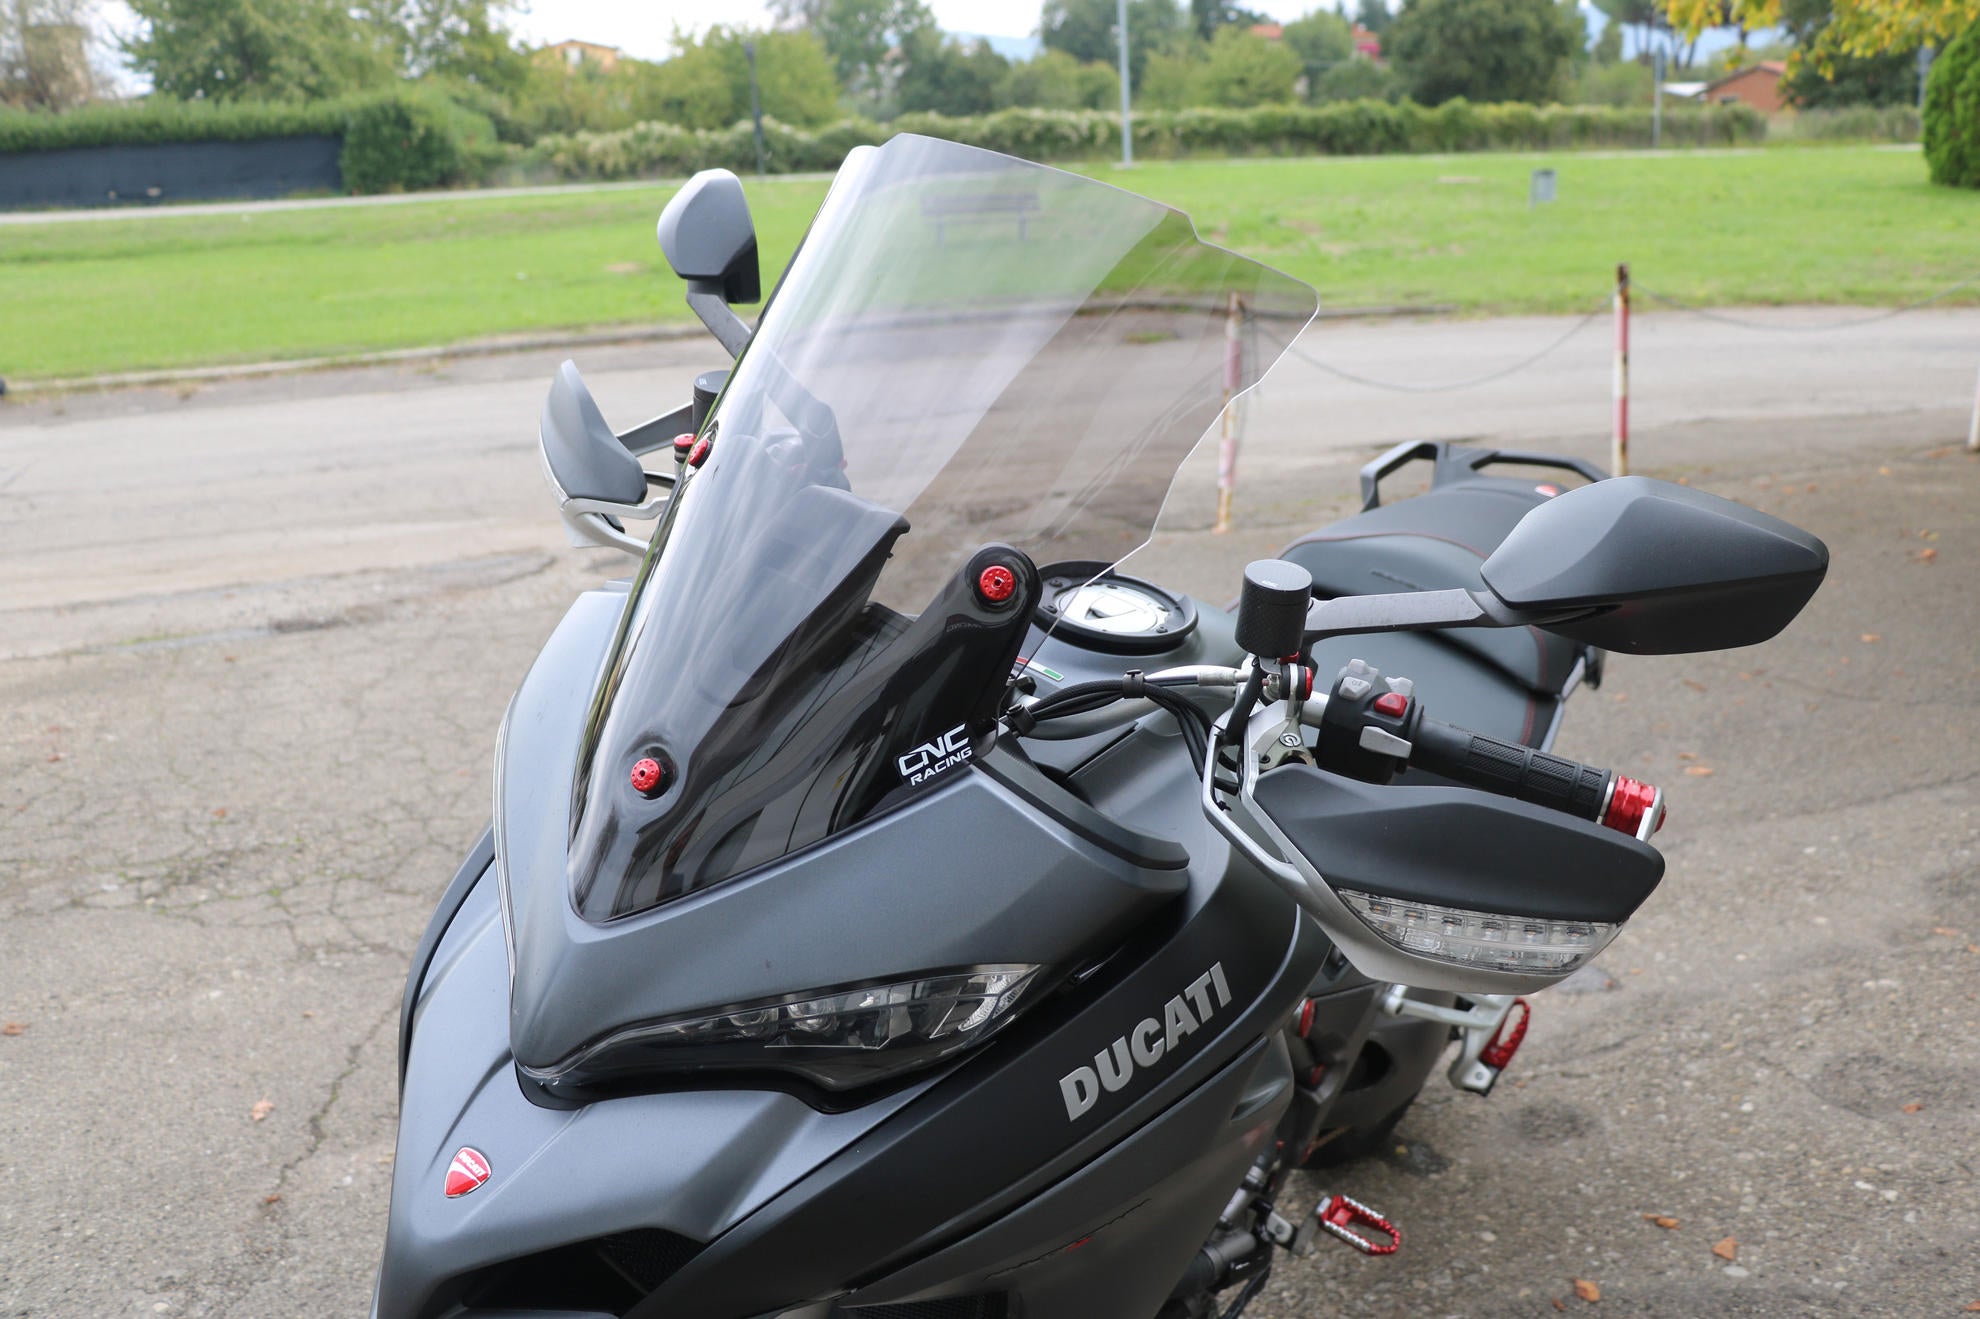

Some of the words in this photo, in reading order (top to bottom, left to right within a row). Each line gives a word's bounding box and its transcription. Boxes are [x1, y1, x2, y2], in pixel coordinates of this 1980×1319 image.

[898, 723, 969, 776] CNC
[910, 746, 973, 786] RACING
[1058, 960, 1233, 1122] DUCATI
